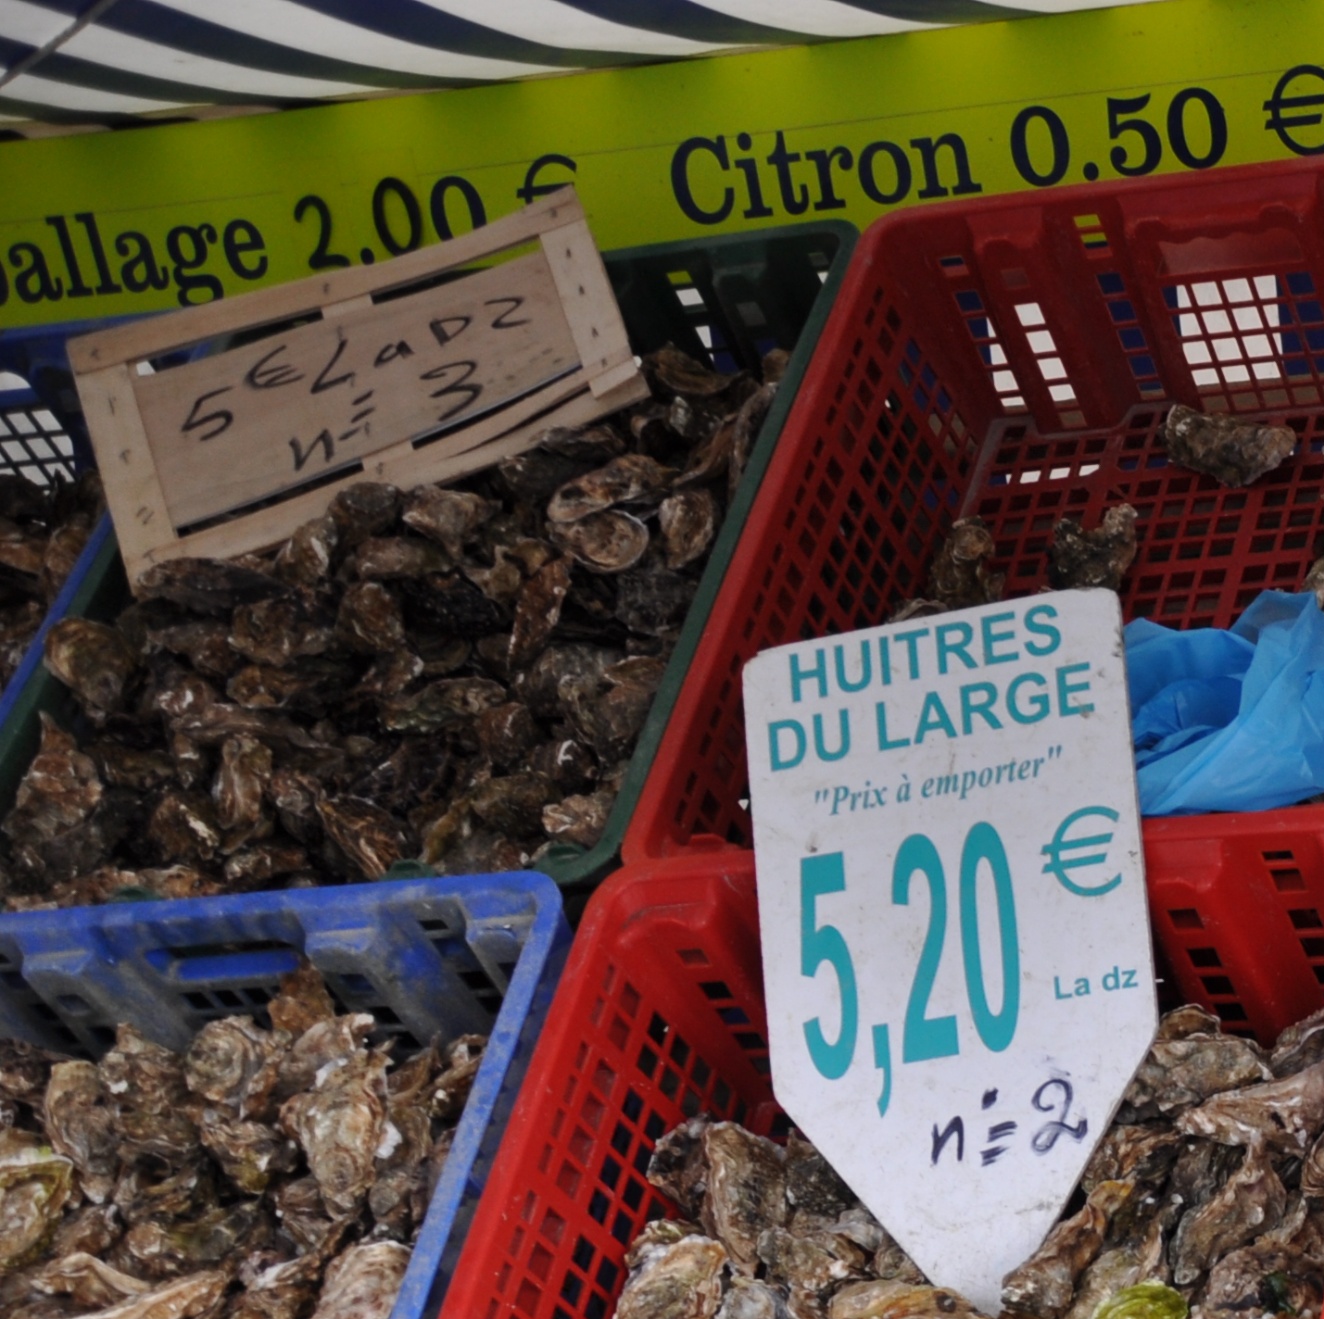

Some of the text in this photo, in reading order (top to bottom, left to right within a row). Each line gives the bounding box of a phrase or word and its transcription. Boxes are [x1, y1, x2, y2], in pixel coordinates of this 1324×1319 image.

[670, 130, 982, 226] Citron
[1009, 87, 1228, 189] 0.50
[0, 212, 268, 307] allage
[294, 175, 488, 270] 2.00
[789, 604, 1062, 702] HUITRES
[768, 662, 1094, 771] DU LARGE
[896, 773, 911, 803] à
[801, 821, 1020, 1118] 5,20
[1053, 965, 1138, 999] La dz
